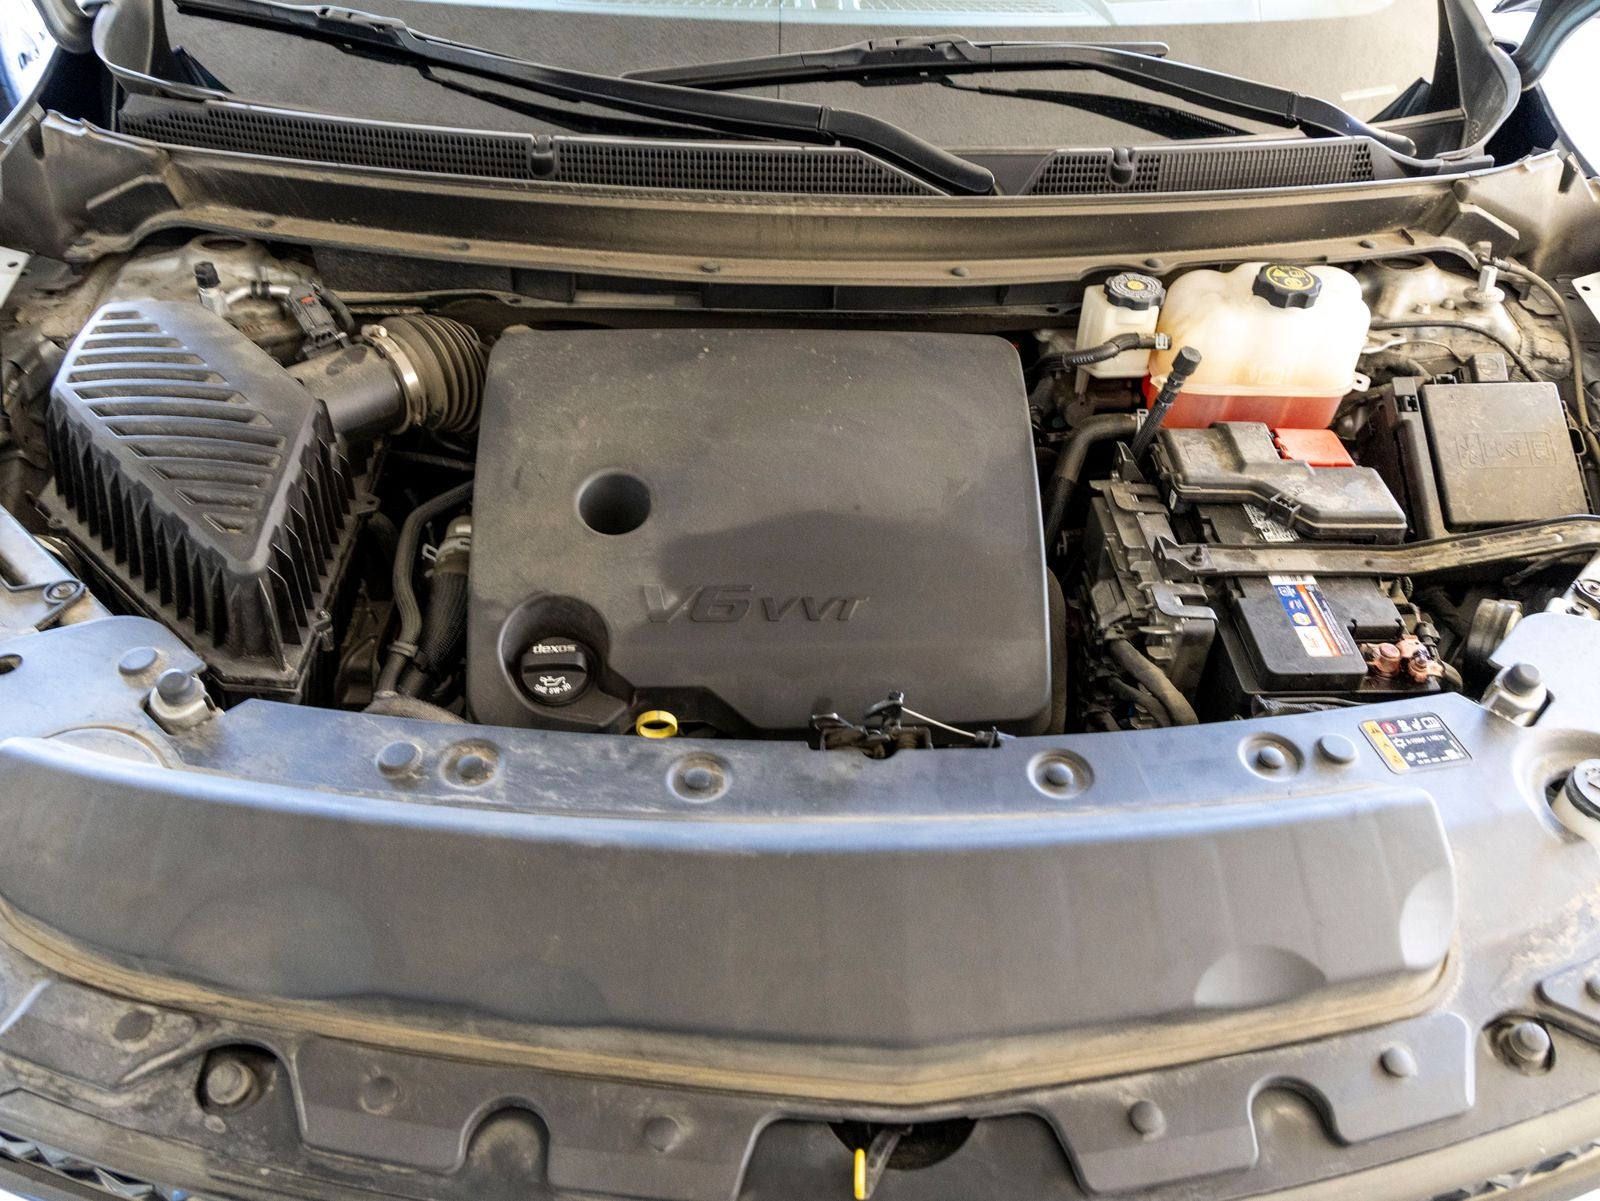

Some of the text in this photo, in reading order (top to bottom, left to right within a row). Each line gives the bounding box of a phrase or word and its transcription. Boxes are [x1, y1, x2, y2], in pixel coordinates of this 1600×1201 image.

[642, 584, 870, 623] V6 VVT
[532, 643, 577, 654] dexos
